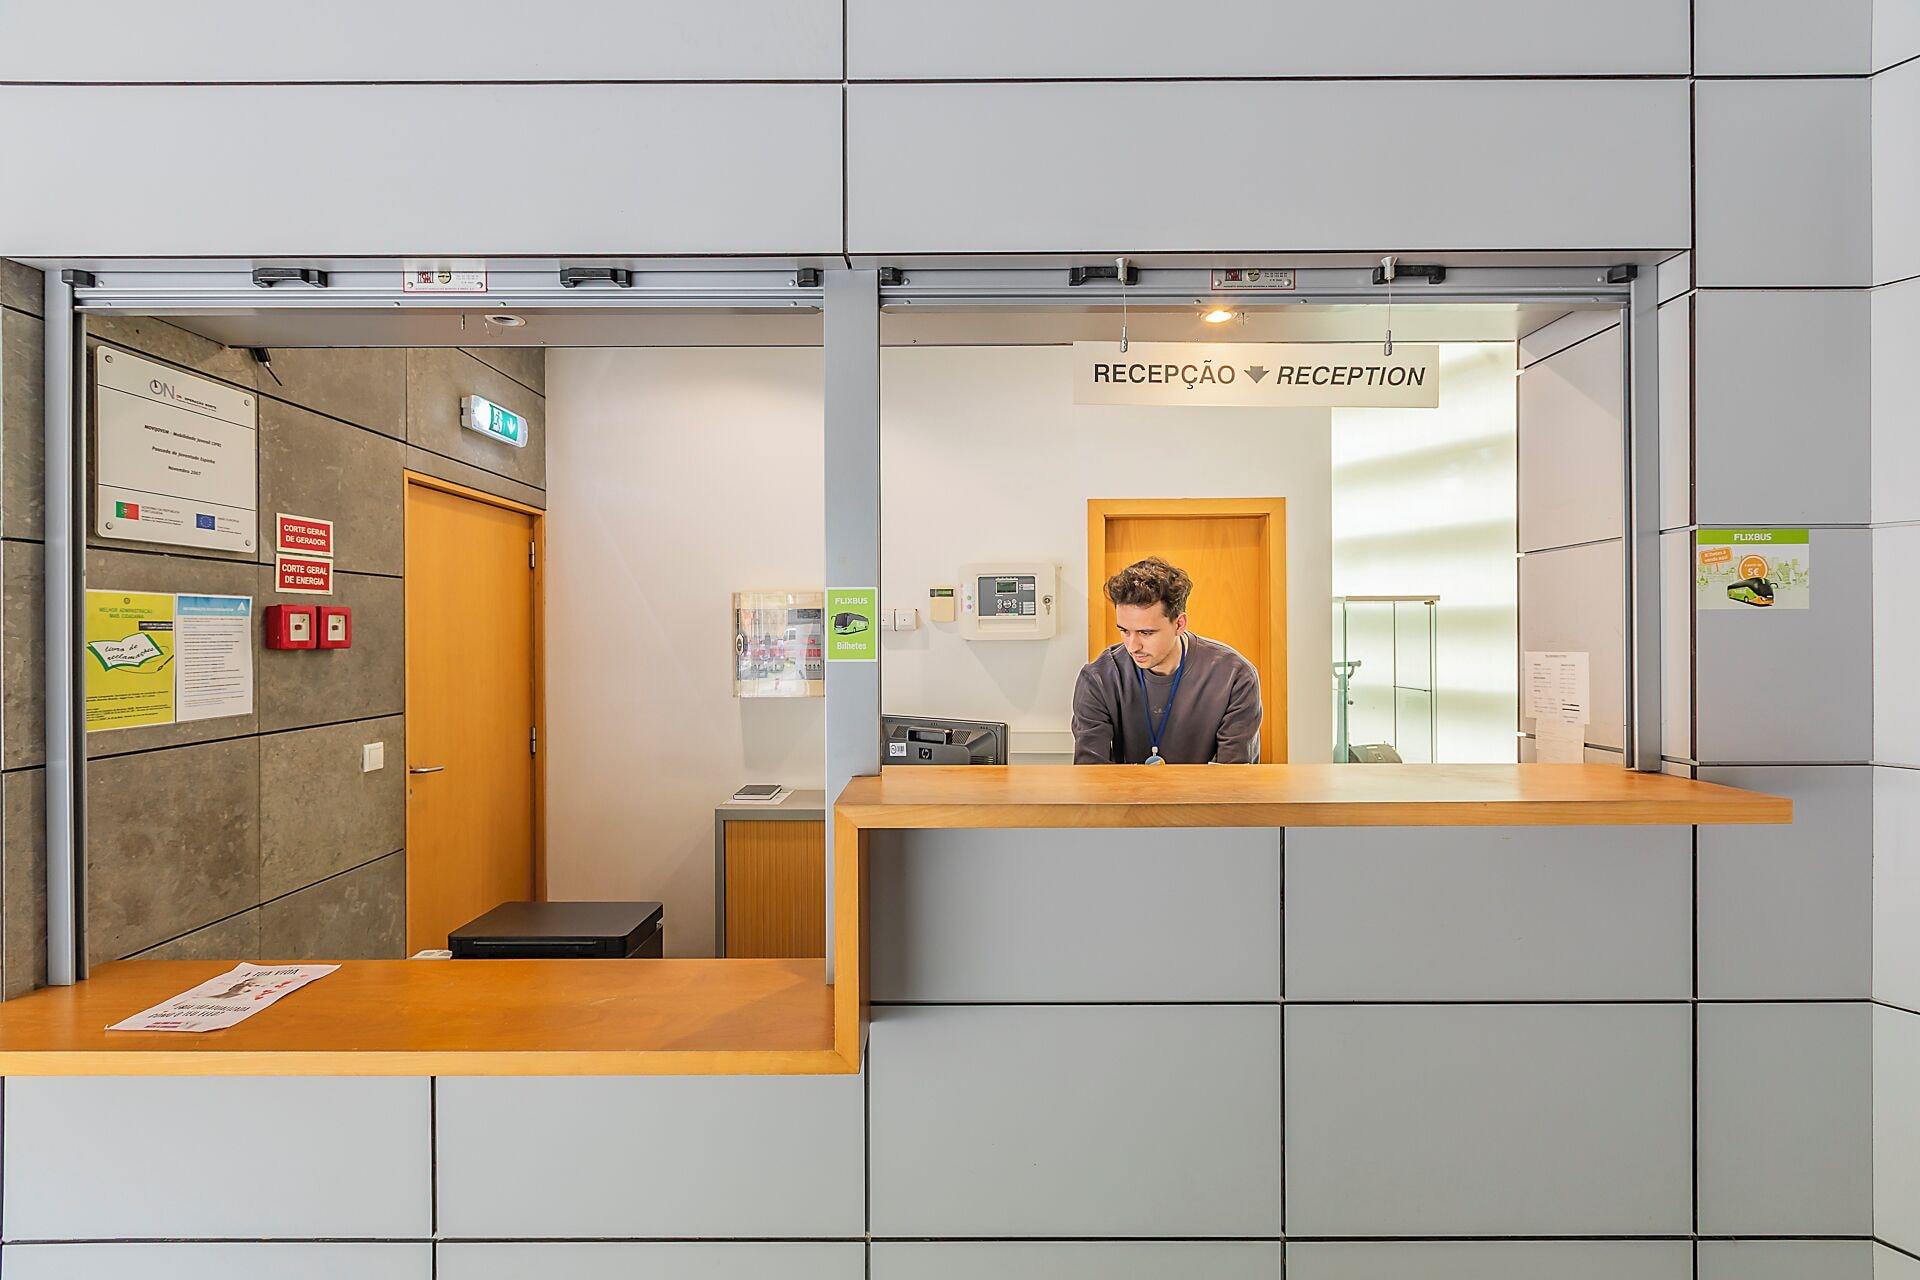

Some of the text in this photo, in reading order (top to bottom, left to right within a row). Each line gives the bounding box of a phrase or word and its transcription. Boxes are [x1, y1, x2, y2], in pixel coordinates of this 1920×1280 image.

[1093, 359, 1427, 390] RECEPÇÃO RECEPTION
[283, 524, 328, 537] CORTE GERAL
[285, 534, 326, 546] DE GERADOR
[281, 563, 328, 576] CORTE GERAL
[284, 575, 325, 586] DE ENERGIA
[836, 641, 867, 650] Bilhetes
